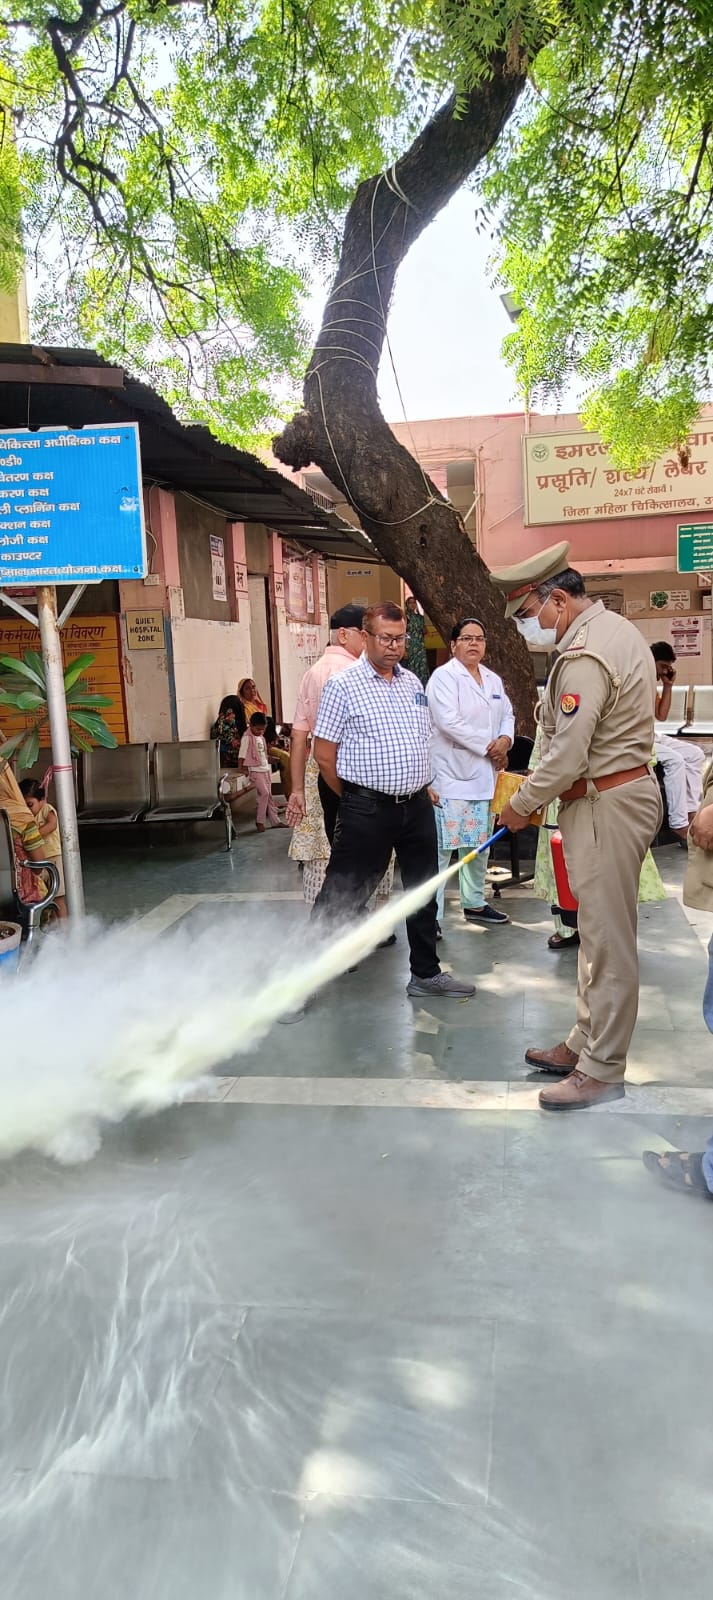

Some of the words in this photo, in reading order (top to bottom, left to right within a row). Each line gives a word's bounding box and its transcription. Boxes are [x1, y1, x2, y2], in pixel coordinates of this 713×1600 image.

[98, 435, 121, 445] कक्ष
[32, 471, 54, 481] कक्ष
[563, 506, 591, 517] जिला
[593, 502, 628, 515] महिला
[135, 617, 155, 625] QUIET
